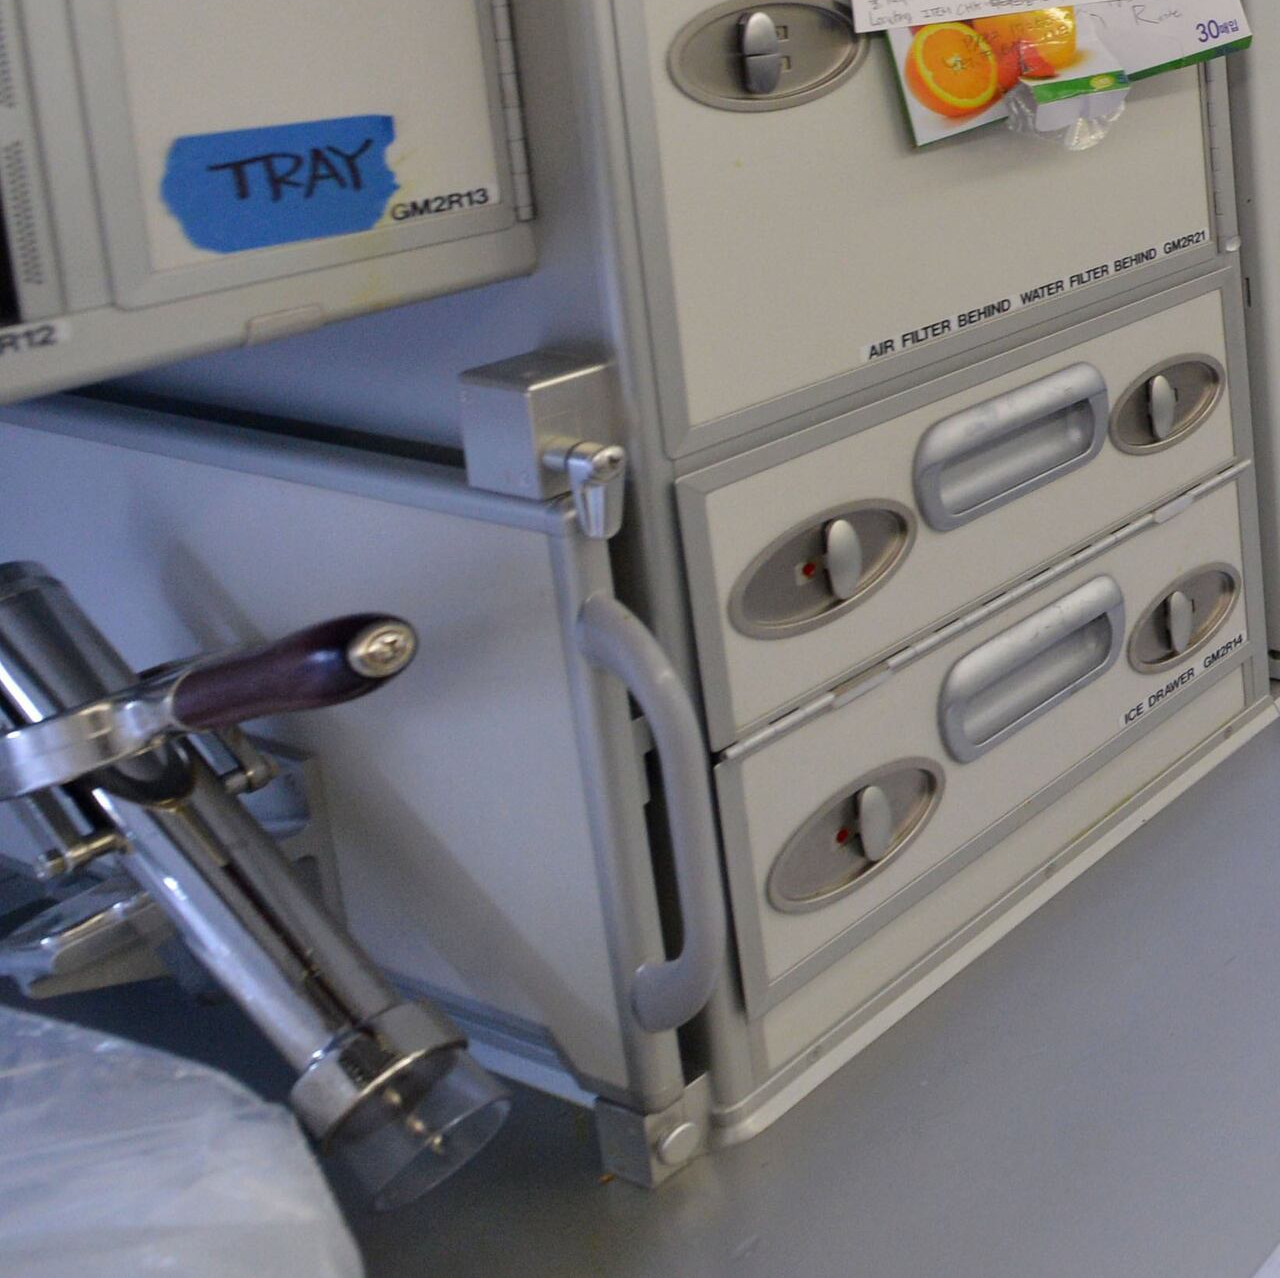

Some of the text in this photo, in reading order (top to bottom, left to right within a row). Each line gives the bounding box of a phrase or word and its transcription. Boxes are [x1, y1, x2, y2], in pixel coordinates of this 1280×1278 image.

[208, 139, 373, 202] TRAY
[390, 187, 490, 222] GM2R13
[869, 230, 1206, 360] AIR FILTER BEHIND WATER FILTER BEHIND GM2R21
[1124, 634, 1244, 724] ICE DRAWER GM2R14
